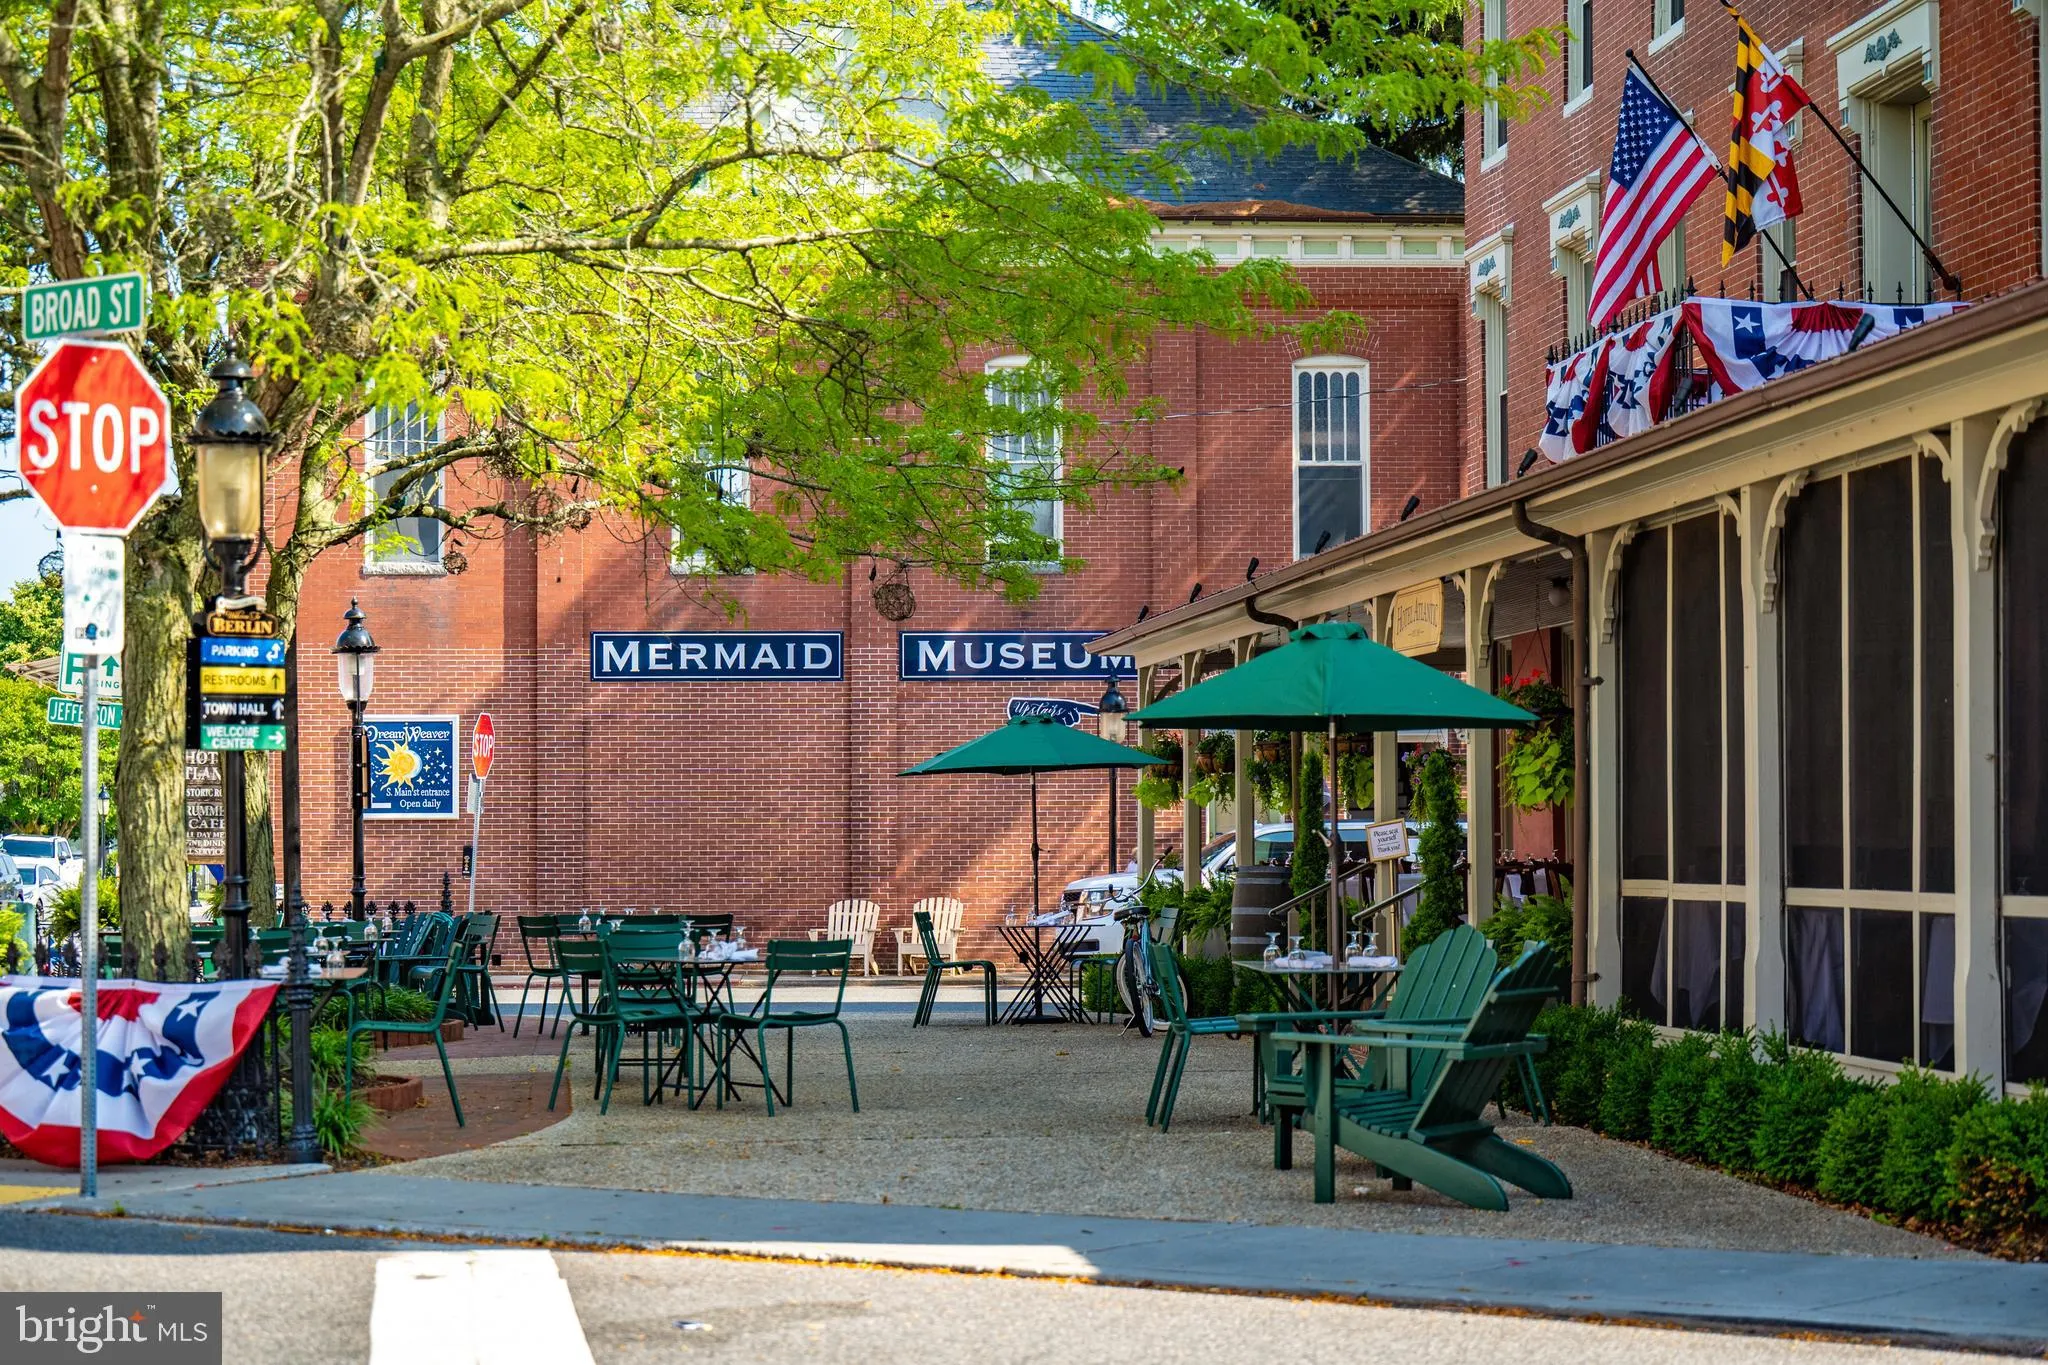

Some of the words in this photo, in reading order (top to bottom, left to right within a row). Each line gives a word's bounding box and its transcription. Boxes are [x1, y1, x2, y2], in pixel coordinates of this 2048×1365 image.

[32, 287, 100, 334] BROAD
[109, 282, 134, 325] ST
[28, 399, 160, 474] STOP
[213, 618, 273, 634] BERLIN
[211, 645, 259, 657] PARKING
[601, 640, 833, 673] MERMAID
[204, 674, 267, 686] RESTROOMS
[50, 702, 115, 727] JEFFESON
[204, 702, 237, 715] TOWN
[238, 703, 268, 716] HALL
[1013, 701, 1066, 717] Upstairs
[206, 727, 260, 738] WELCOME
[212, 738, 254, 749] CENTER
[473, 734, 493, 757] STOP
[186, 751, 218, 765] HOT
[186, 789, 213, 797] STORIC
[394, 788, 411, 796] Main
[400, 800, 421, 809] Open
[423, 799, 441, 809] daily
